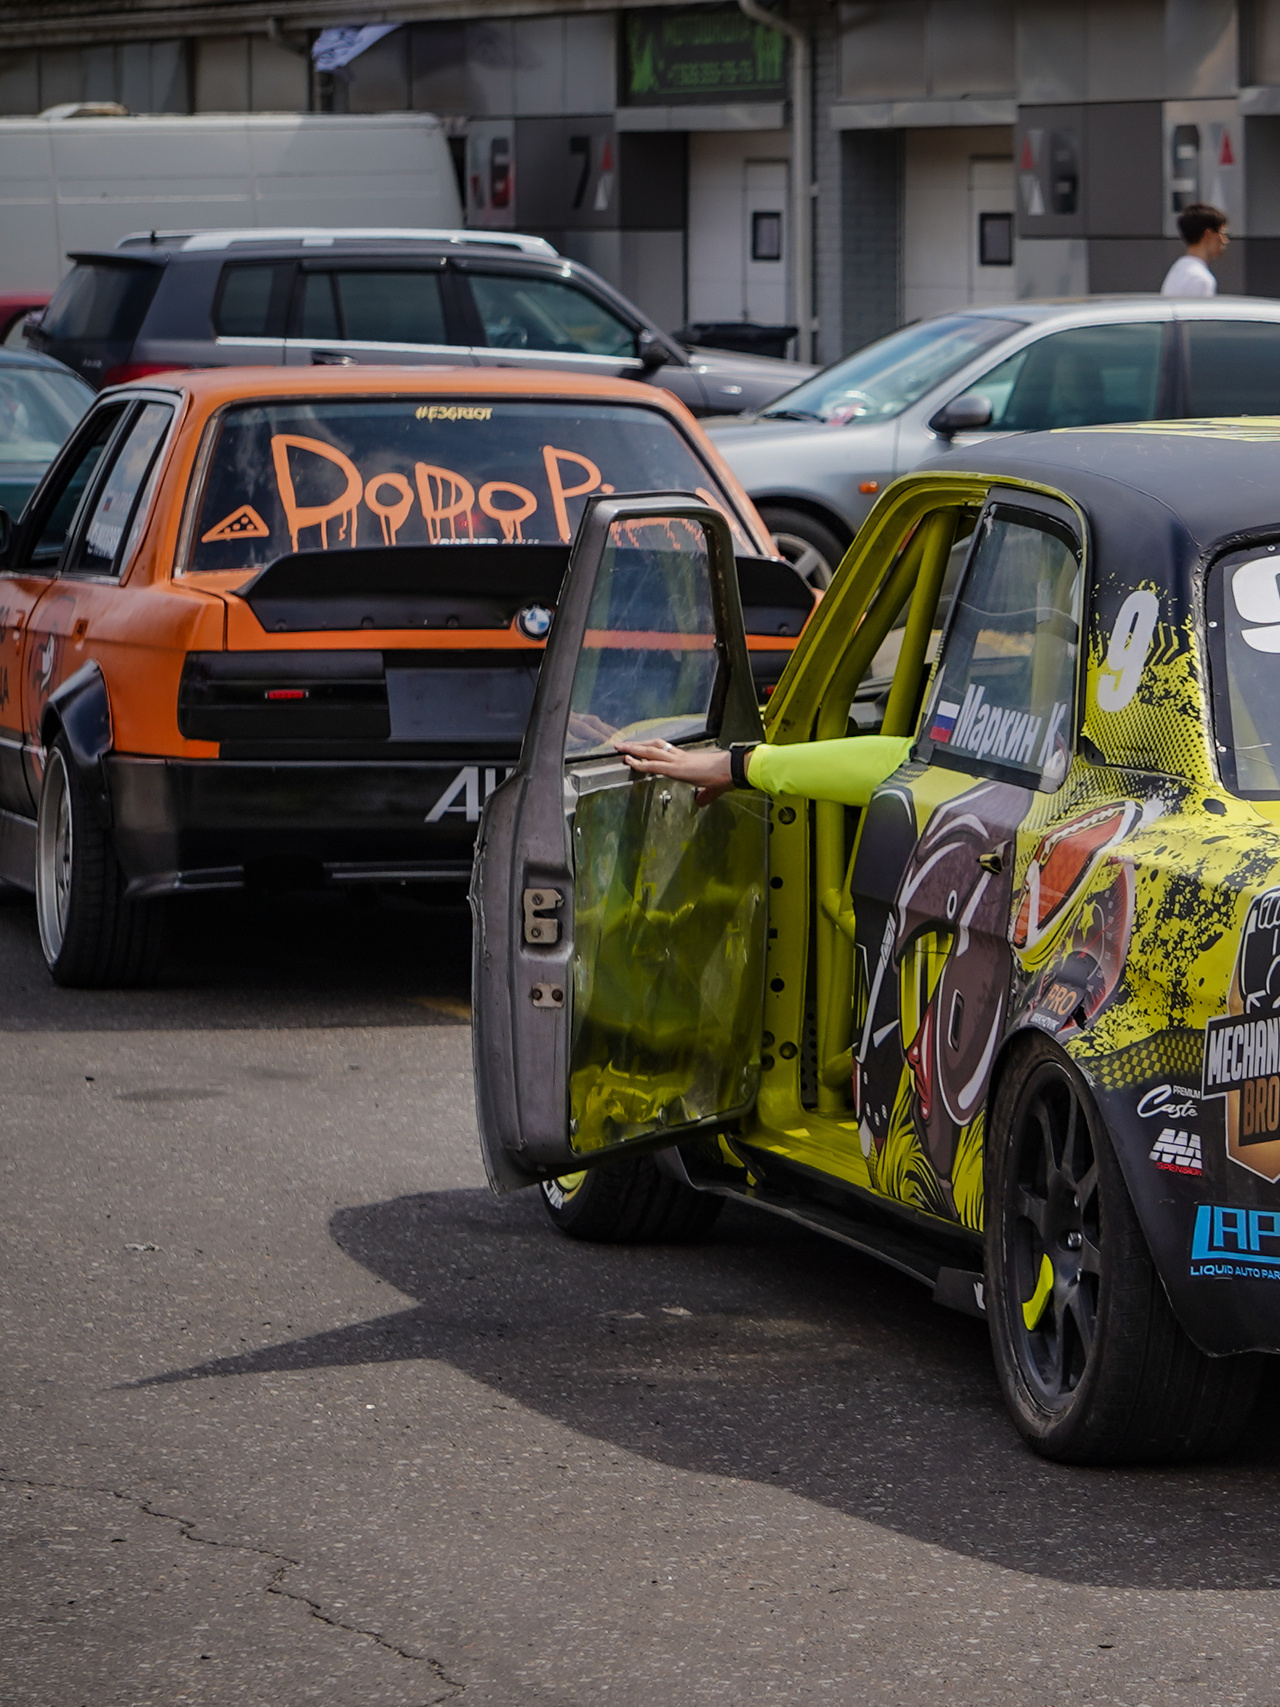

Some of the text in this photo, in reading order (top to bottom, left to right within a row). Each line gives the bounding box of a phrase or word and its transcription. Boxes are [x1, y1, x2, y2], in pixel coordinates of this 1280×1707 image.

[570, 135, 592, 210] 7
[1097, 590, 1160, 713] 9
[951, 683, 1042, 760] Маркин
[1041, 983, 1077, 1016] PRO
[1190, 1265, 1234, 1276] LIQUID
[1235, 1268, 1260, 1278] AUTO
